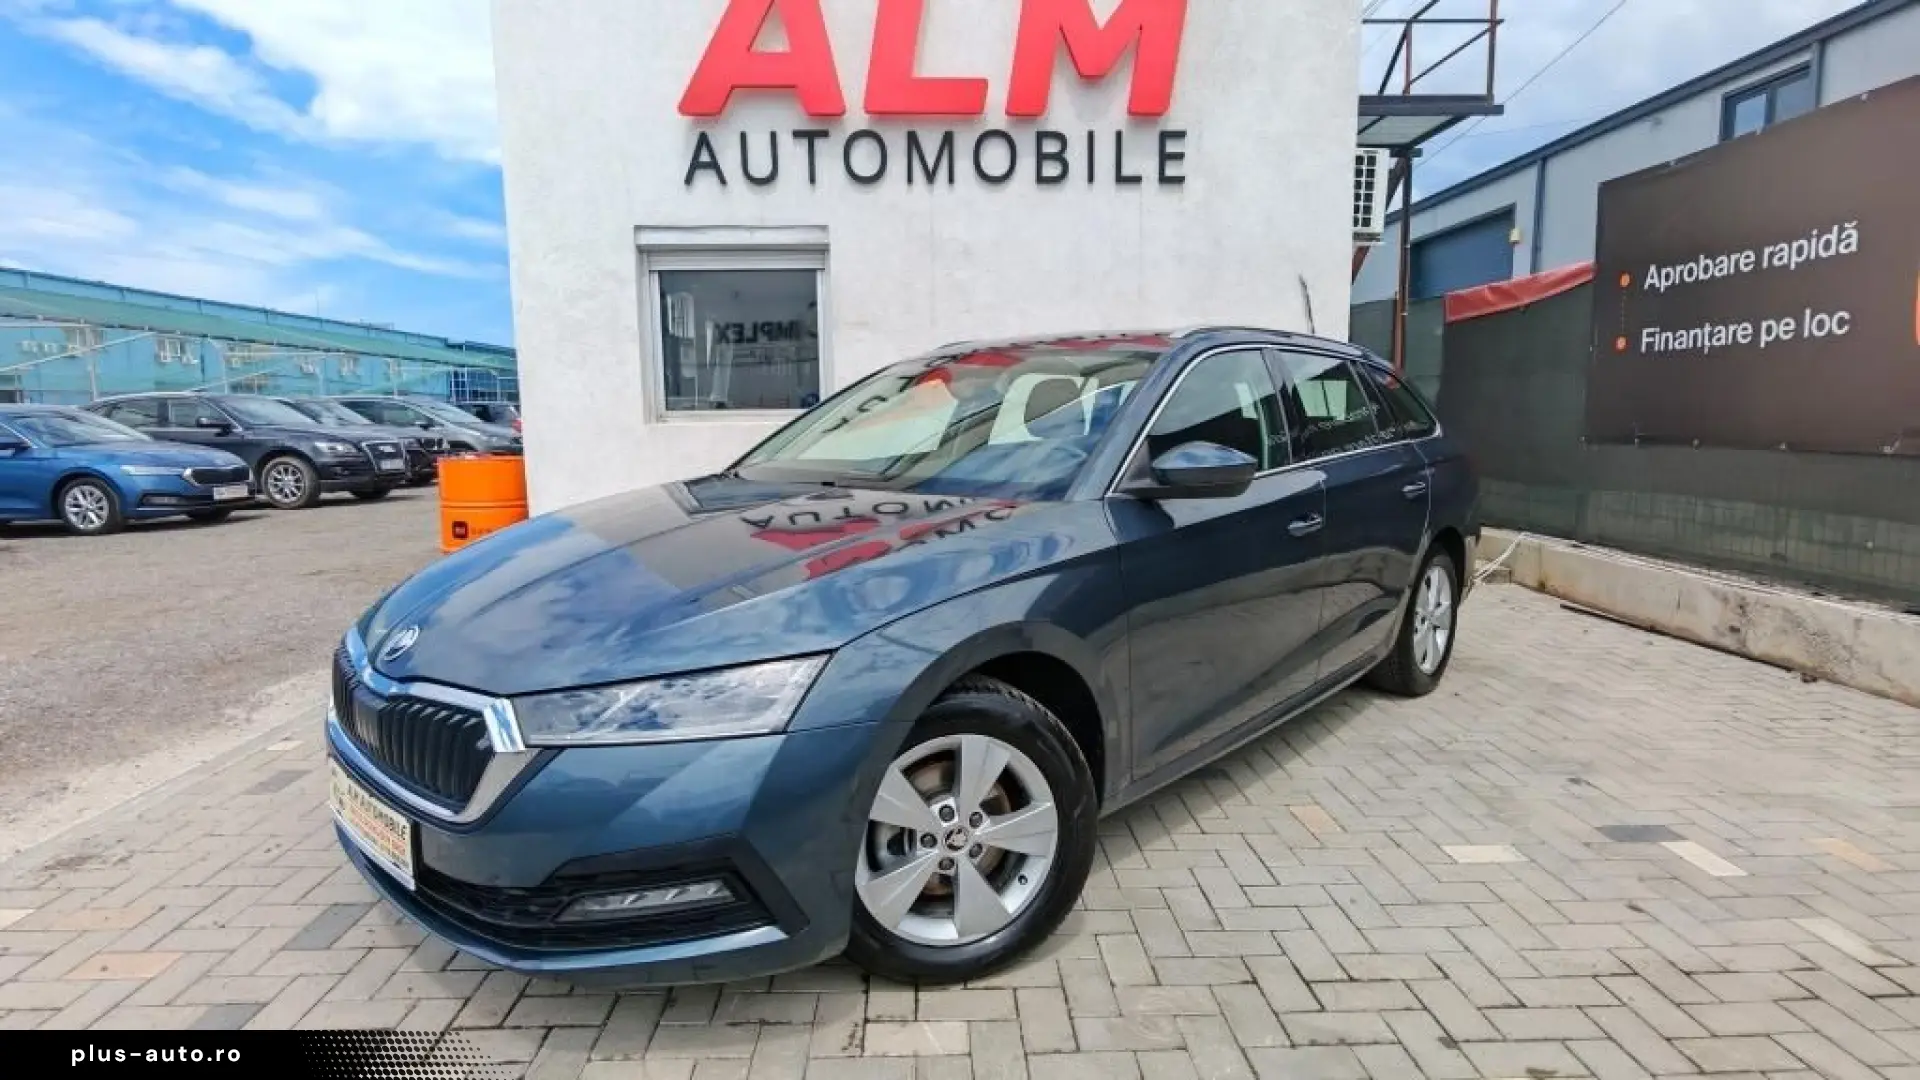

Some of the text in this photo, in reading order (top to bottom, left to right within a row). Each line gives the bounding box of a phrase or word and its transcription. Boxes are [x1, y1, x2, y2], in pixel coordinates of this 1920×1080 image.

[677, 0, 1188, 118] ALM
[683, 128, 1187, 186] AUTOMOBILE
[1644, 220, 1859, 293] Aprobare rapidă
[1640, 308, 1851, 354] Finanțare pe loc
